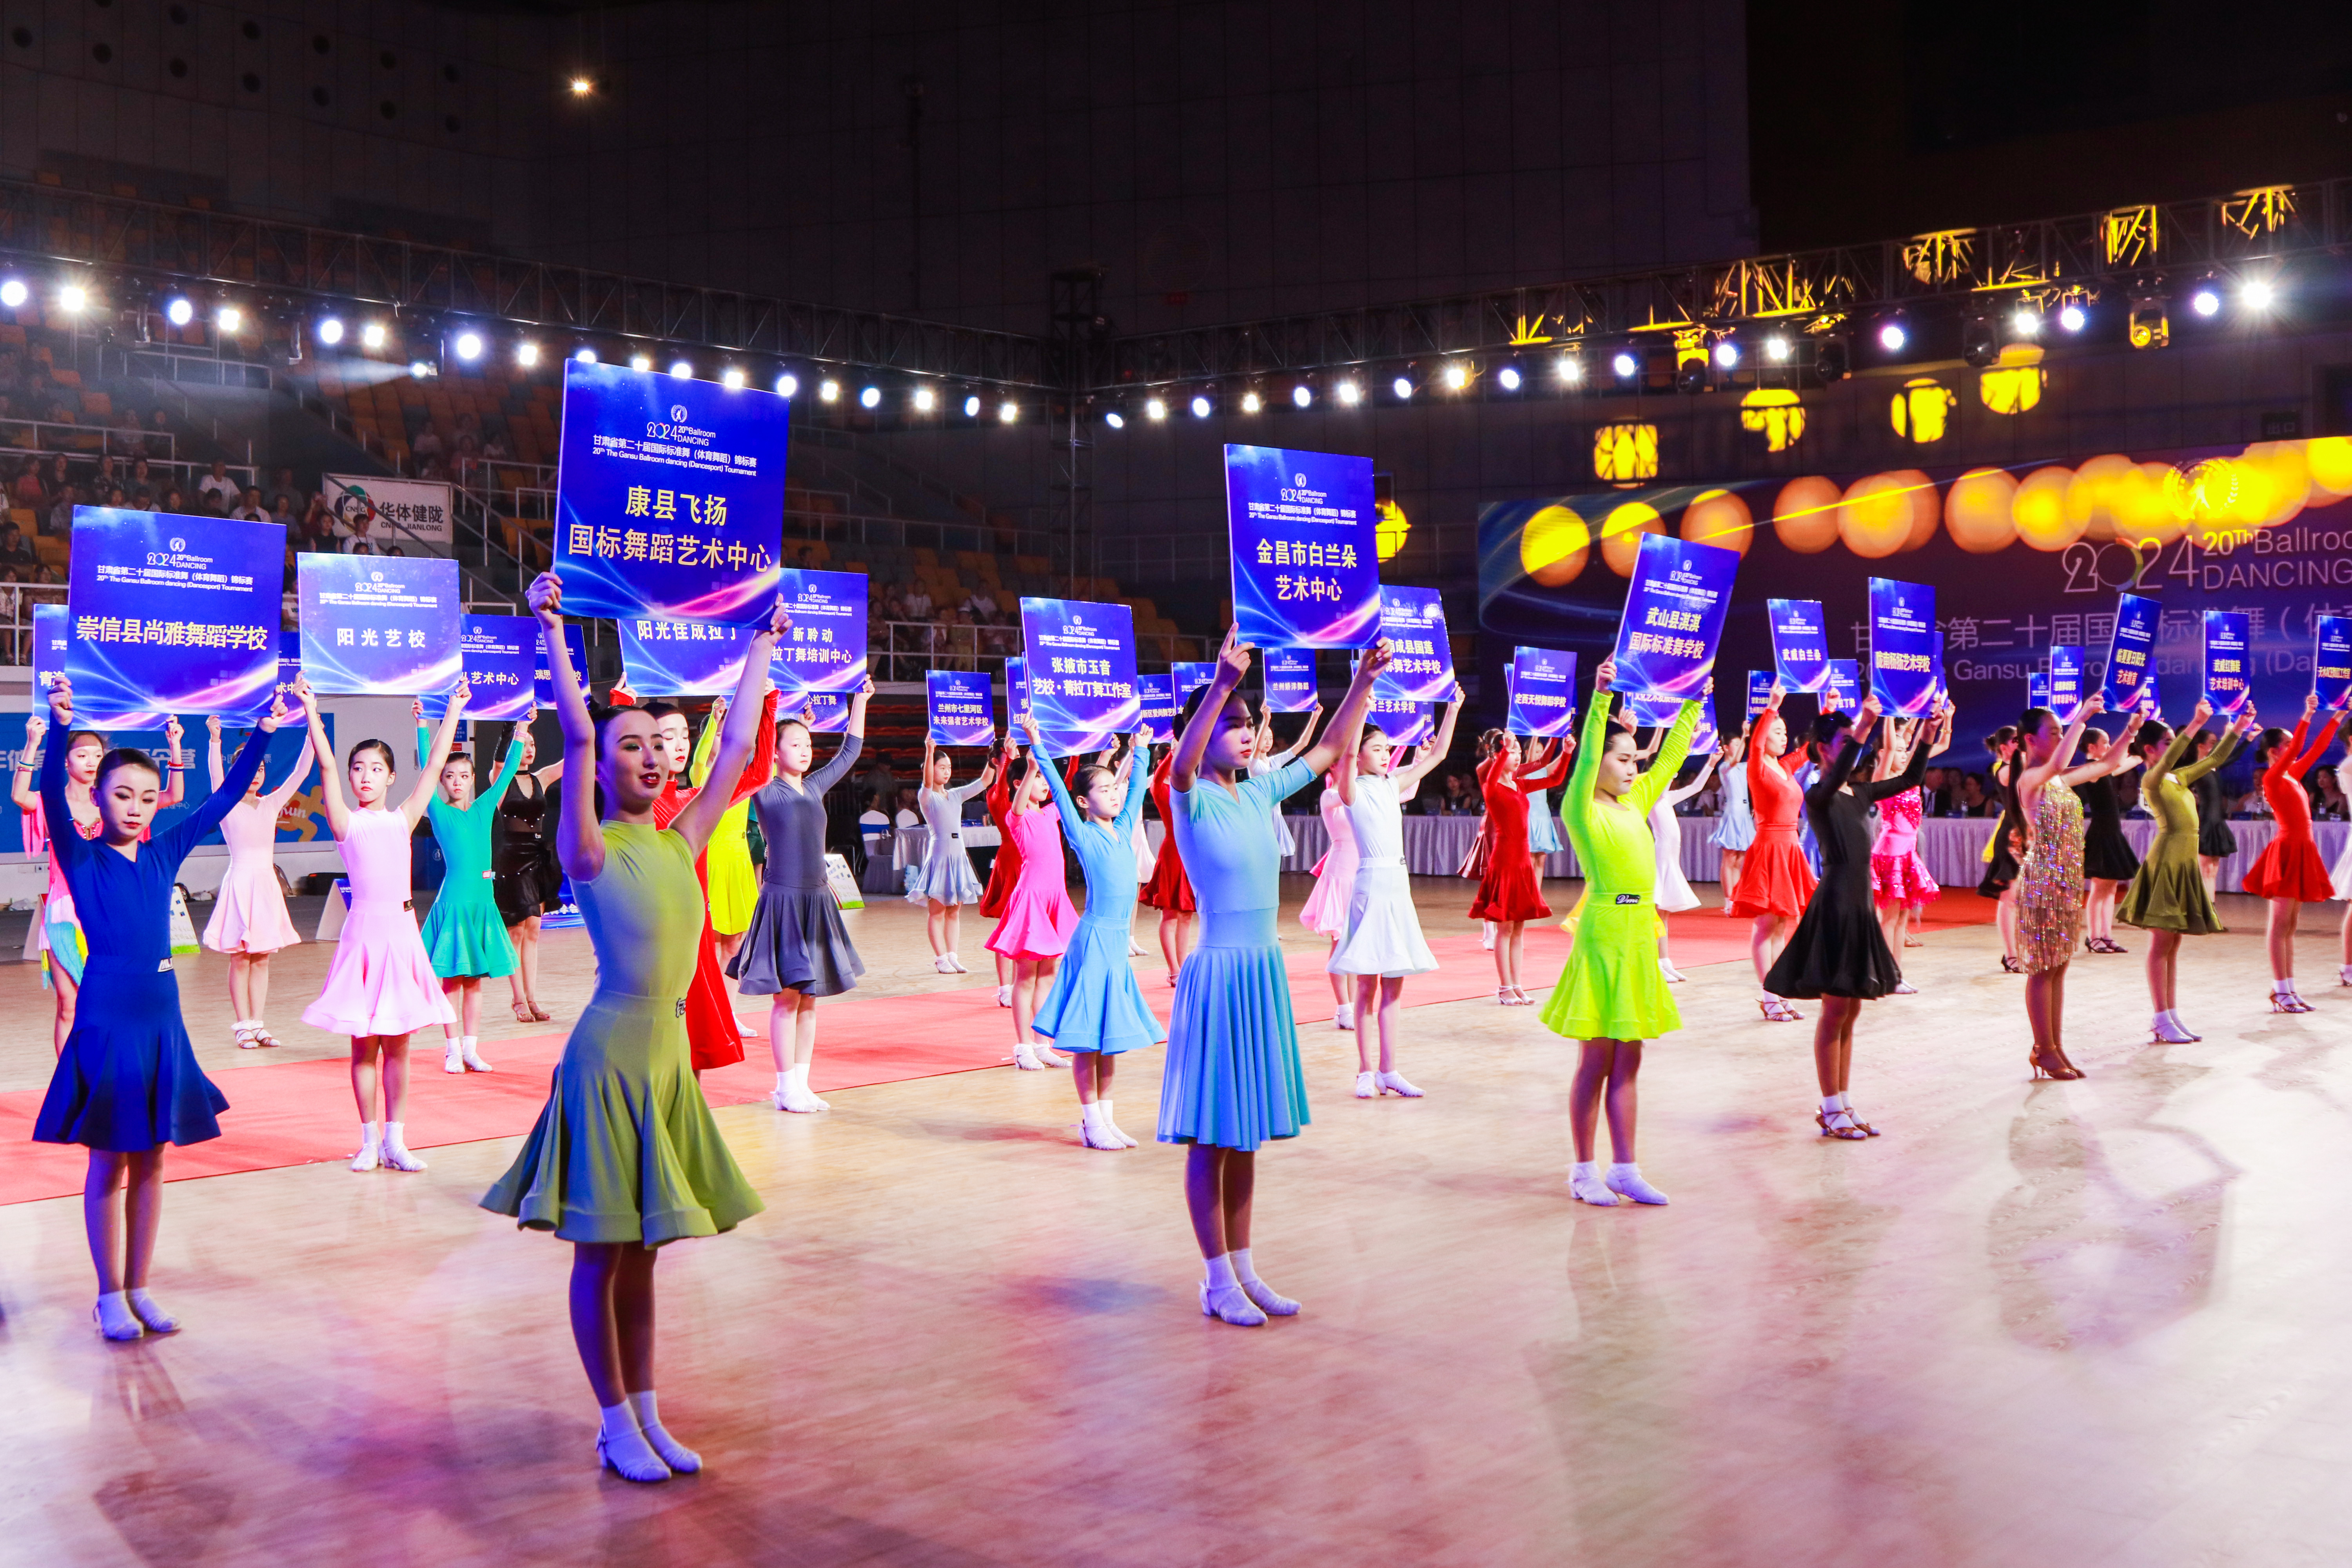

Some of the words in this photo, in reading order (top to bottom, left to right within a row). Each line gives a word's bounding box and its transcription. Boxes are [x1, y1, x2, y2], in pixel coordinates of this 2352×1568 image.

[647, 421, 677, 441] 2024
[677, 434, 709, 446] DANCING
[689, 426, 716, 438] Ballroom
[593, 434, 757, 468] 甘肃省第二十届国际标准舞（体育舞蹈）锦标赛
[619, 451, 638, 460] Gansu
[639, 454, 664, 464] Ballroom
[665, 457, 687, 468] dancing
[689, 461, 723, 472] (Dancesport)
[725, 466, 757, 477] Tournament
[1281, 488, 1301, 502] 2024
[379, 501, 443, 523] 华体健陇
[625, 485, 726, 526] 康县飞扬
[568, 524, 771, 573] 国标舞蹈艺术中心
[1256, 538, 1357, 568] 金昌市白兰朵
[147, 552, 176, 567] 2024
[187, 555, 213, 563] Ballroom
[2062, 535, 2199, 592] 2024
[97, 565, 253, 585] 甘肃省第二十届国际标准舞（体育舞蹈）锦标赛
[165, 579, 186, 588] dancing
[187, 581, 221, 590] (Dancesport)
[221, 584, 253, 592] Tournament
[355, 582, 377, 592] 2024
[1276, 575, 1342, 601] 艺术中心
[1645, 606, 1702, 632] 武山县淇淇
[76, 616, 267, 651] 崇信县尚雅舞蹈学校
[337, 628, 425, 648] 阳光艺校
[772, 646, 852, 663] 拉丁舞培训中心
[1629, 631, 1705, 659] 国际标准舞学校
[1052, 657, 1111, 676] 张掖市玉音
[938, 703, 983, 713] 兰州市七里河区
[933, 715, 989, 726] 未来强者艺术学校
